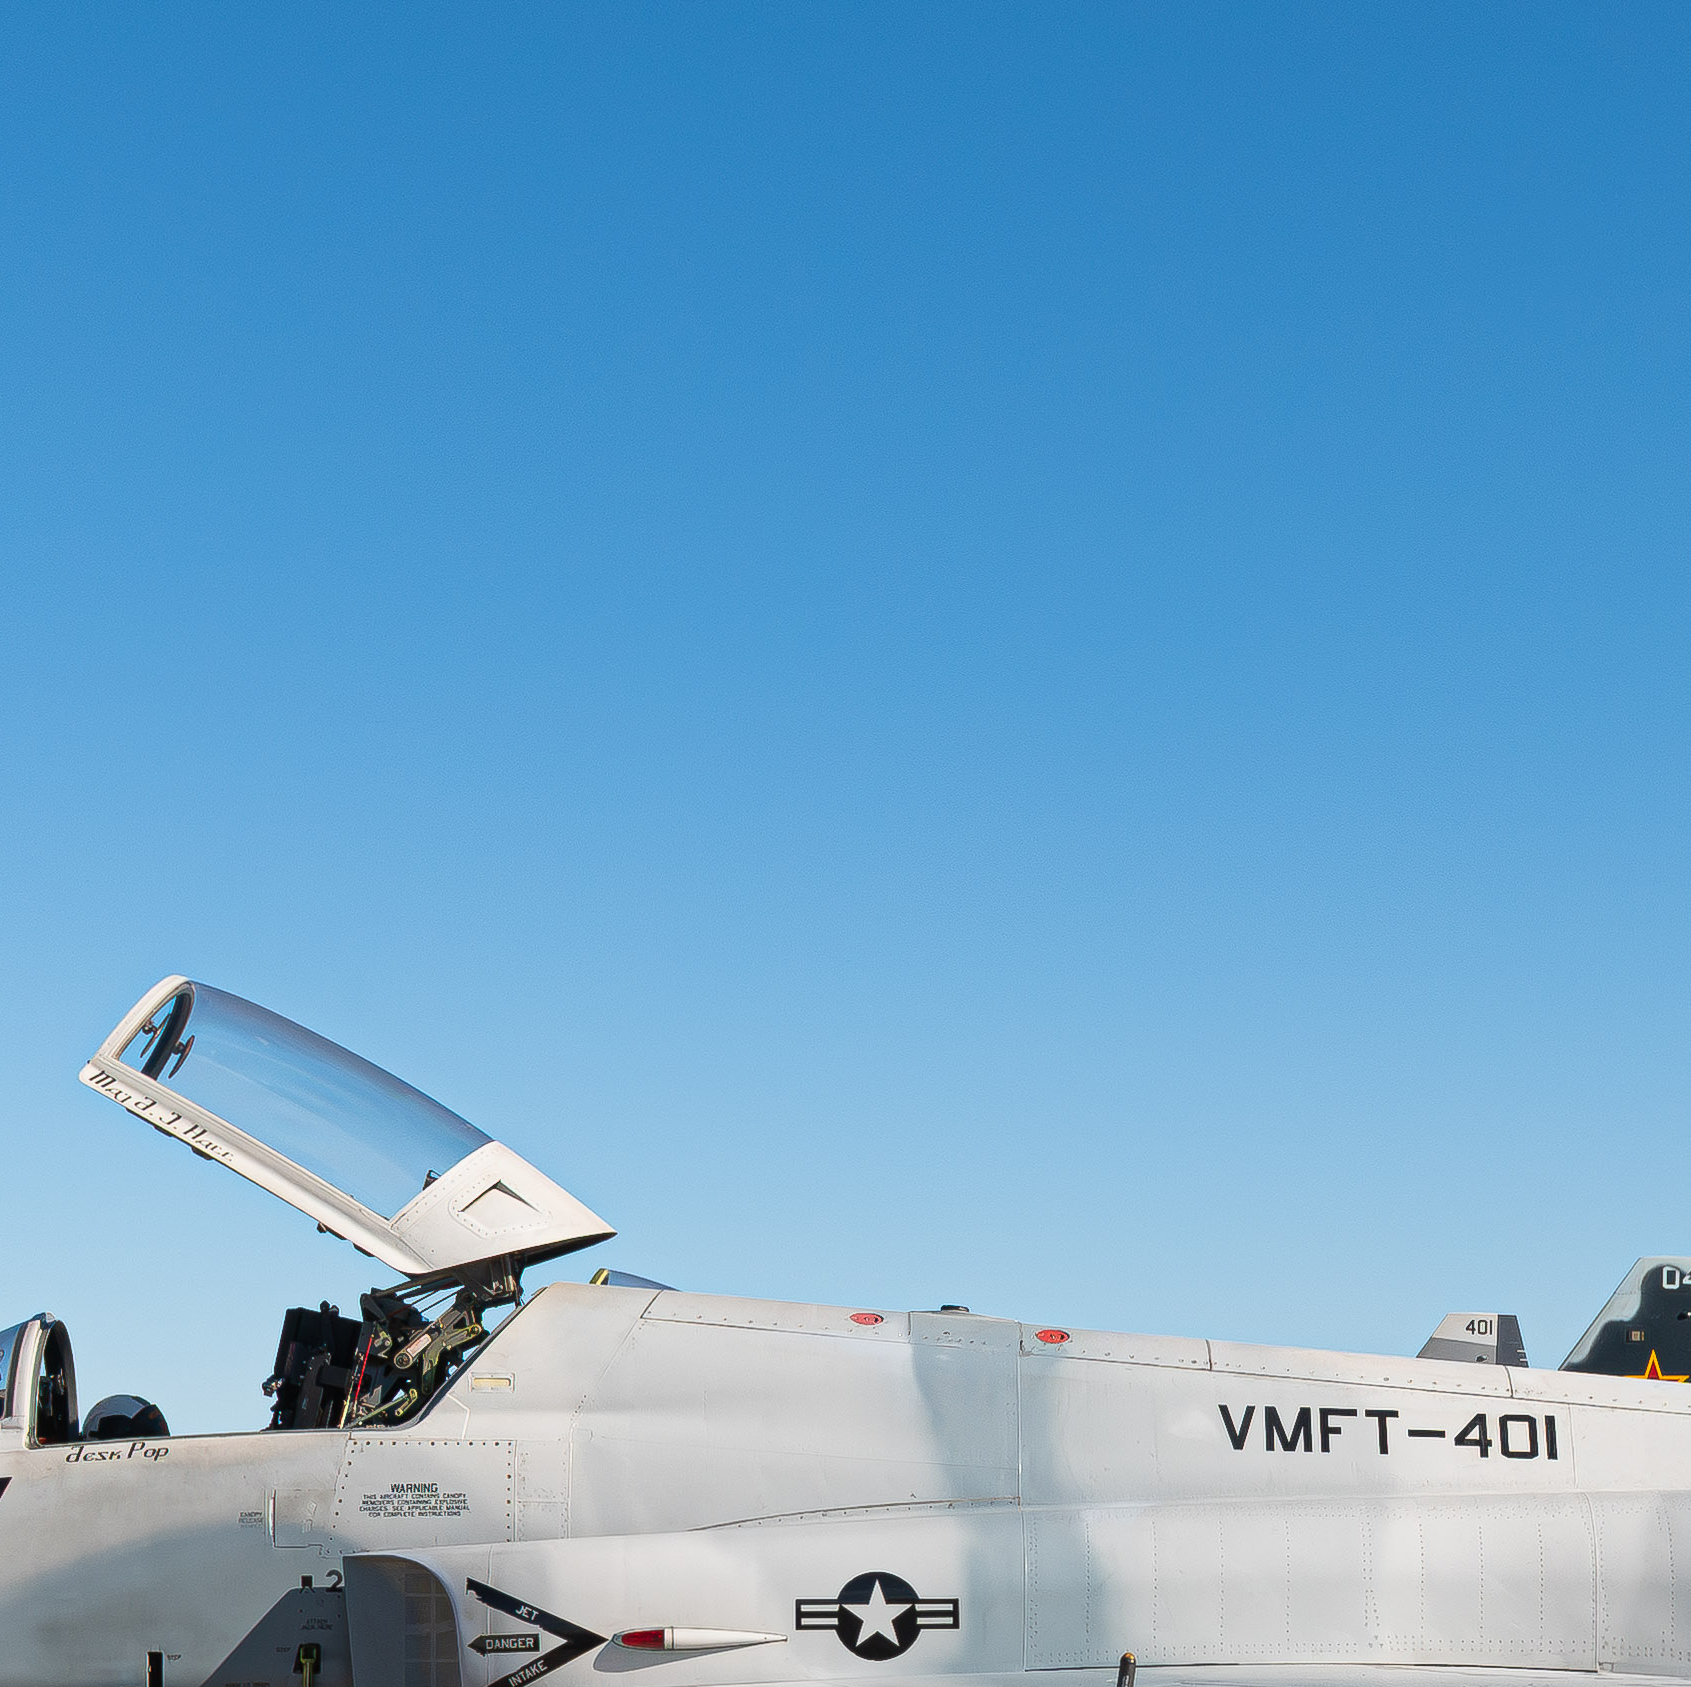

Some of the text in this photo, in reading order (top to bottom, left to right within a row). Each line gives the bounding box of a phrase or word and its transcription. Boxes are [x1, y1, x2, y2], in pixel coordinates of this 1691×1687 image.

[1465, 1319, 1493, 1335] 401
[1218, 1404, 1558, 1460] VMFT-401
[390, 1483, 438, 1493] WARNING
[325, 1569, 343, 1592] 2
[515, 1605, 540, 1621] JET
[485, 1638, 535, 1649] DANGER
[508, 1659, 548, 1687] INTAKE
